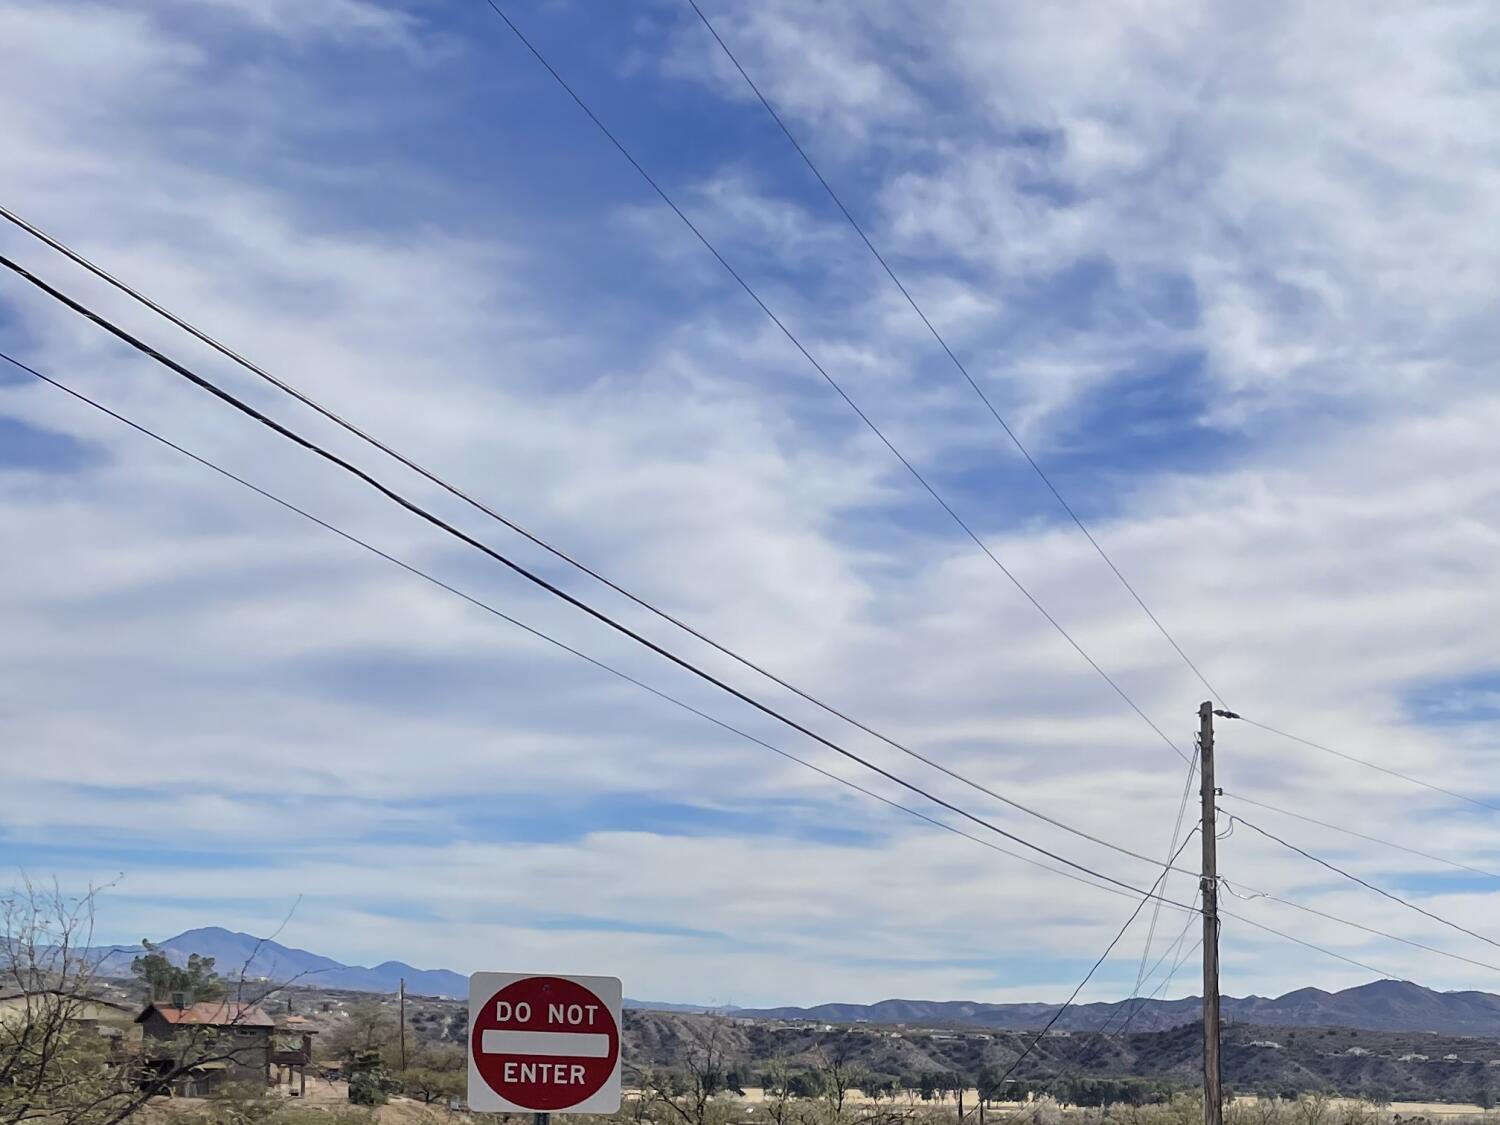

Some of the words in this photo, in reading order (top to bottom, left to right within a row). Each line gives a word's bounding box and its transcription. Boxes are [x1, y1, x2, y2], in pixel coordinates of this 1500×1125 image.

[496, 1001, 532, 1023] DO
[548, 1003, 599, 1025] NOT
[503, 1062, 586, 1085] ENTER
